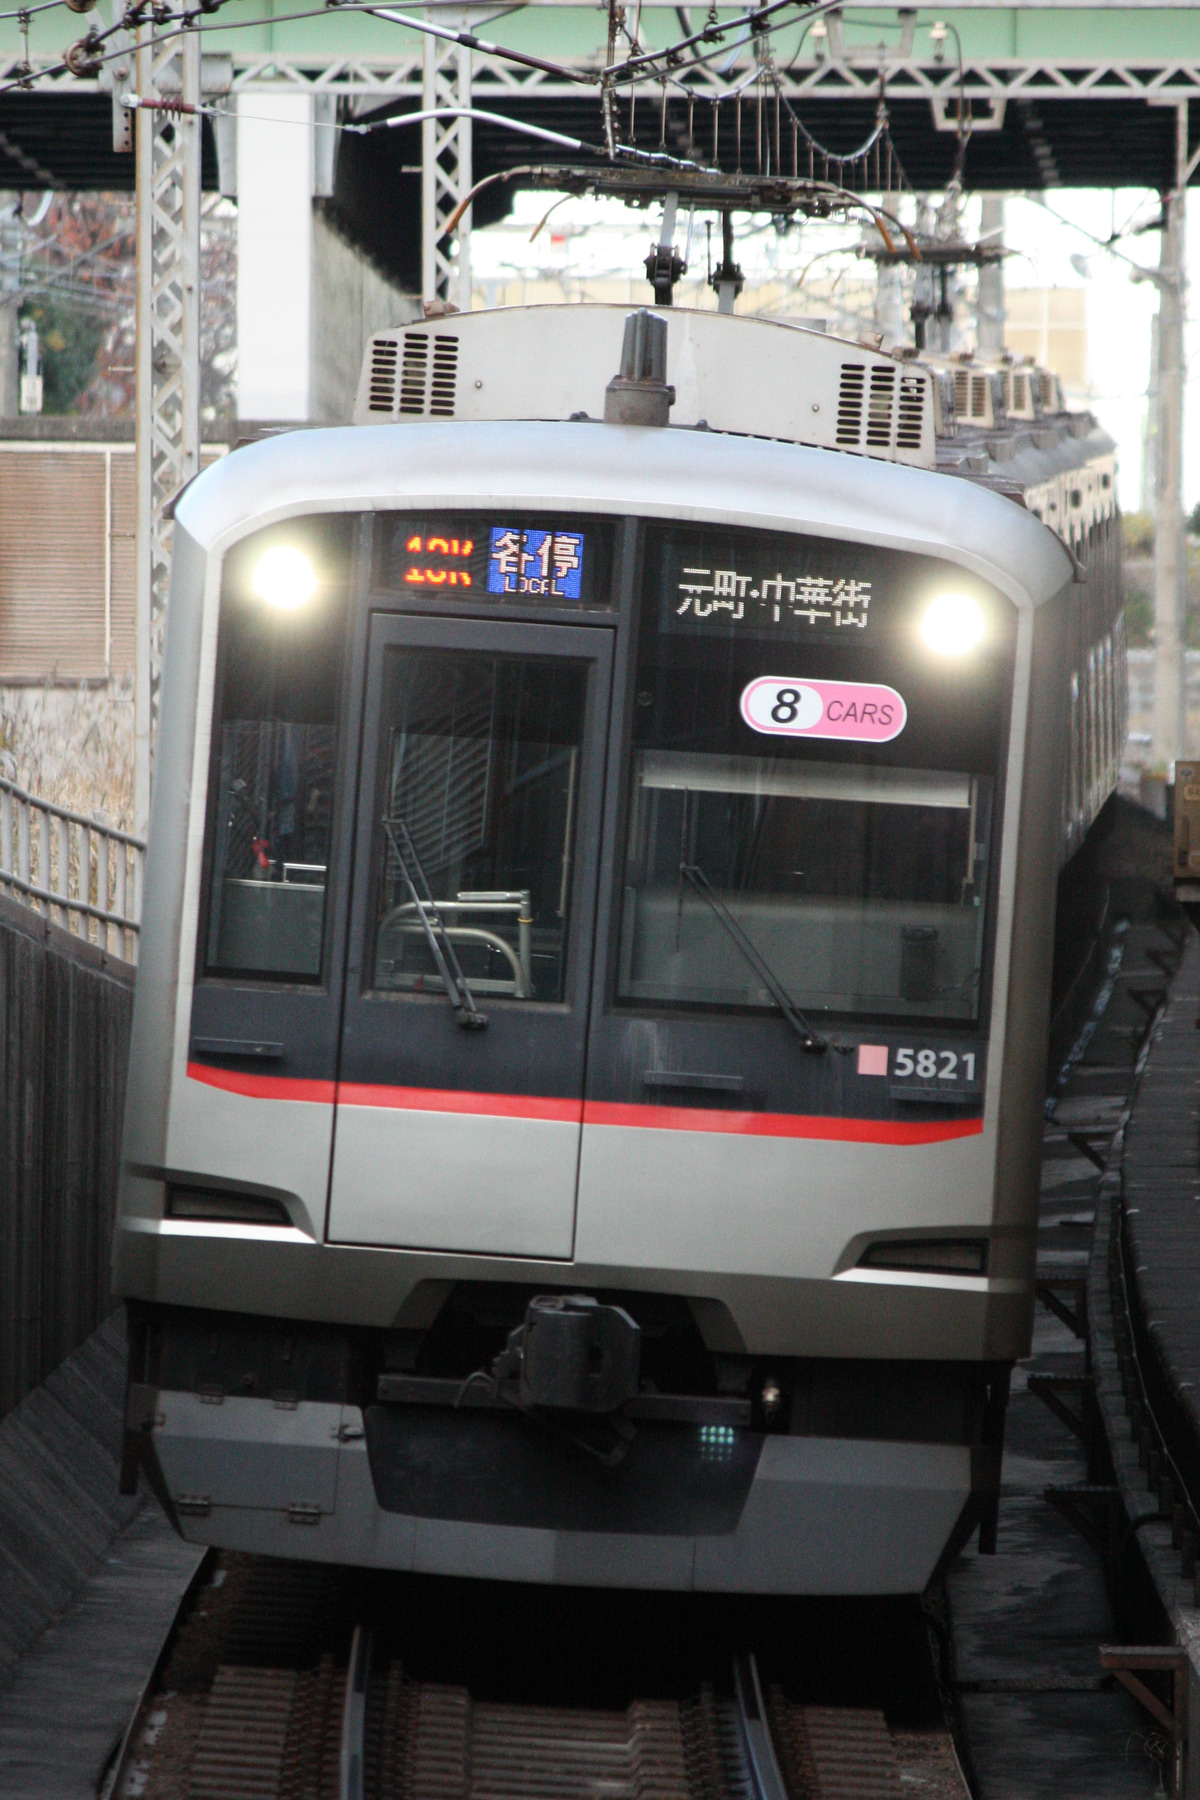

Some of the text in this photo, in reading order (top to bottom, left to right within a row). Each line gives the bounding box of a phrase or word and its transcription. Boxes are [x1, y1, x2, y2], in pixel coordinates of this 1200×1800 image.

[491, 532, 580, 577] 各停
[504, 576, 564, 596] LOCAL
[771, 688, 894, 726] 8 CARS
[894, 1048, 975, 1081] 5821
